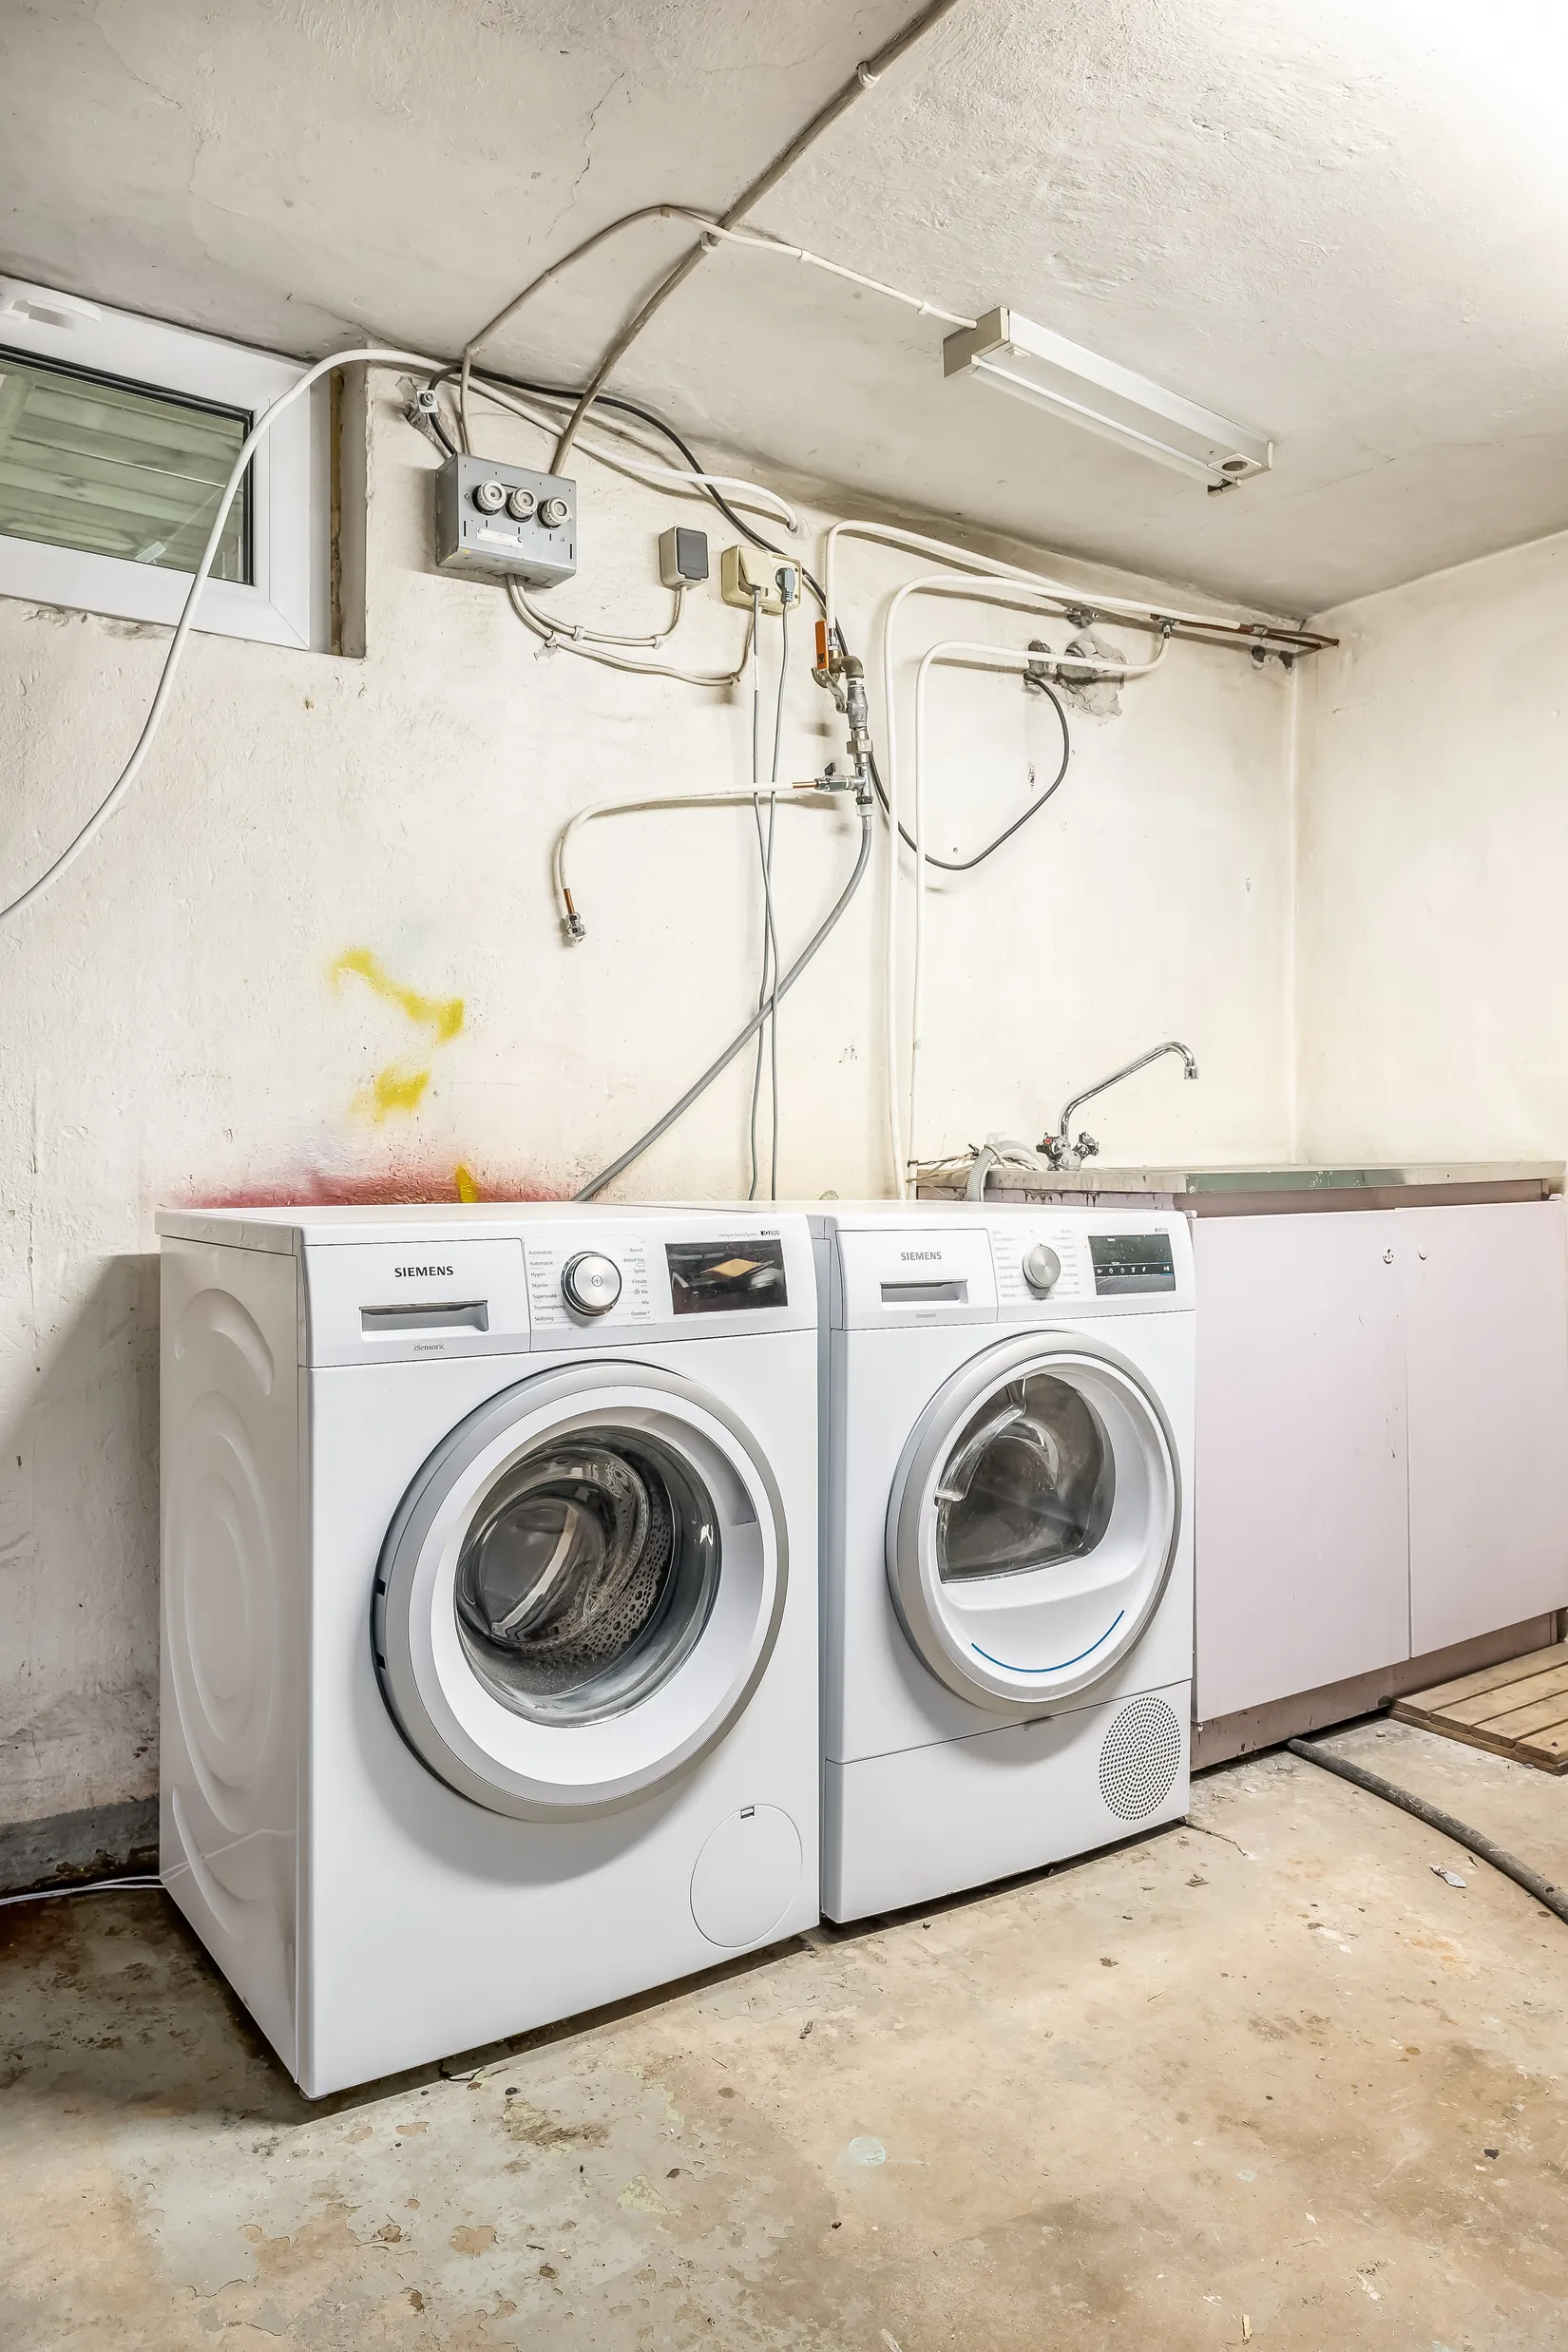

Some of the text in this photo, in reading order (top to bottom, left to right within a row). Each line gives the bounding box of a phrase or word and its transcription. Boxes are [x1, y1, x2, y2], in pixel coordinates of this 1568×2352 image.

[900, 1251, 943, 1261] SIEMENS
[394, 1266, 454, 1277] SIEMENS
[413, 1343, 445, 1351] iSensoric
